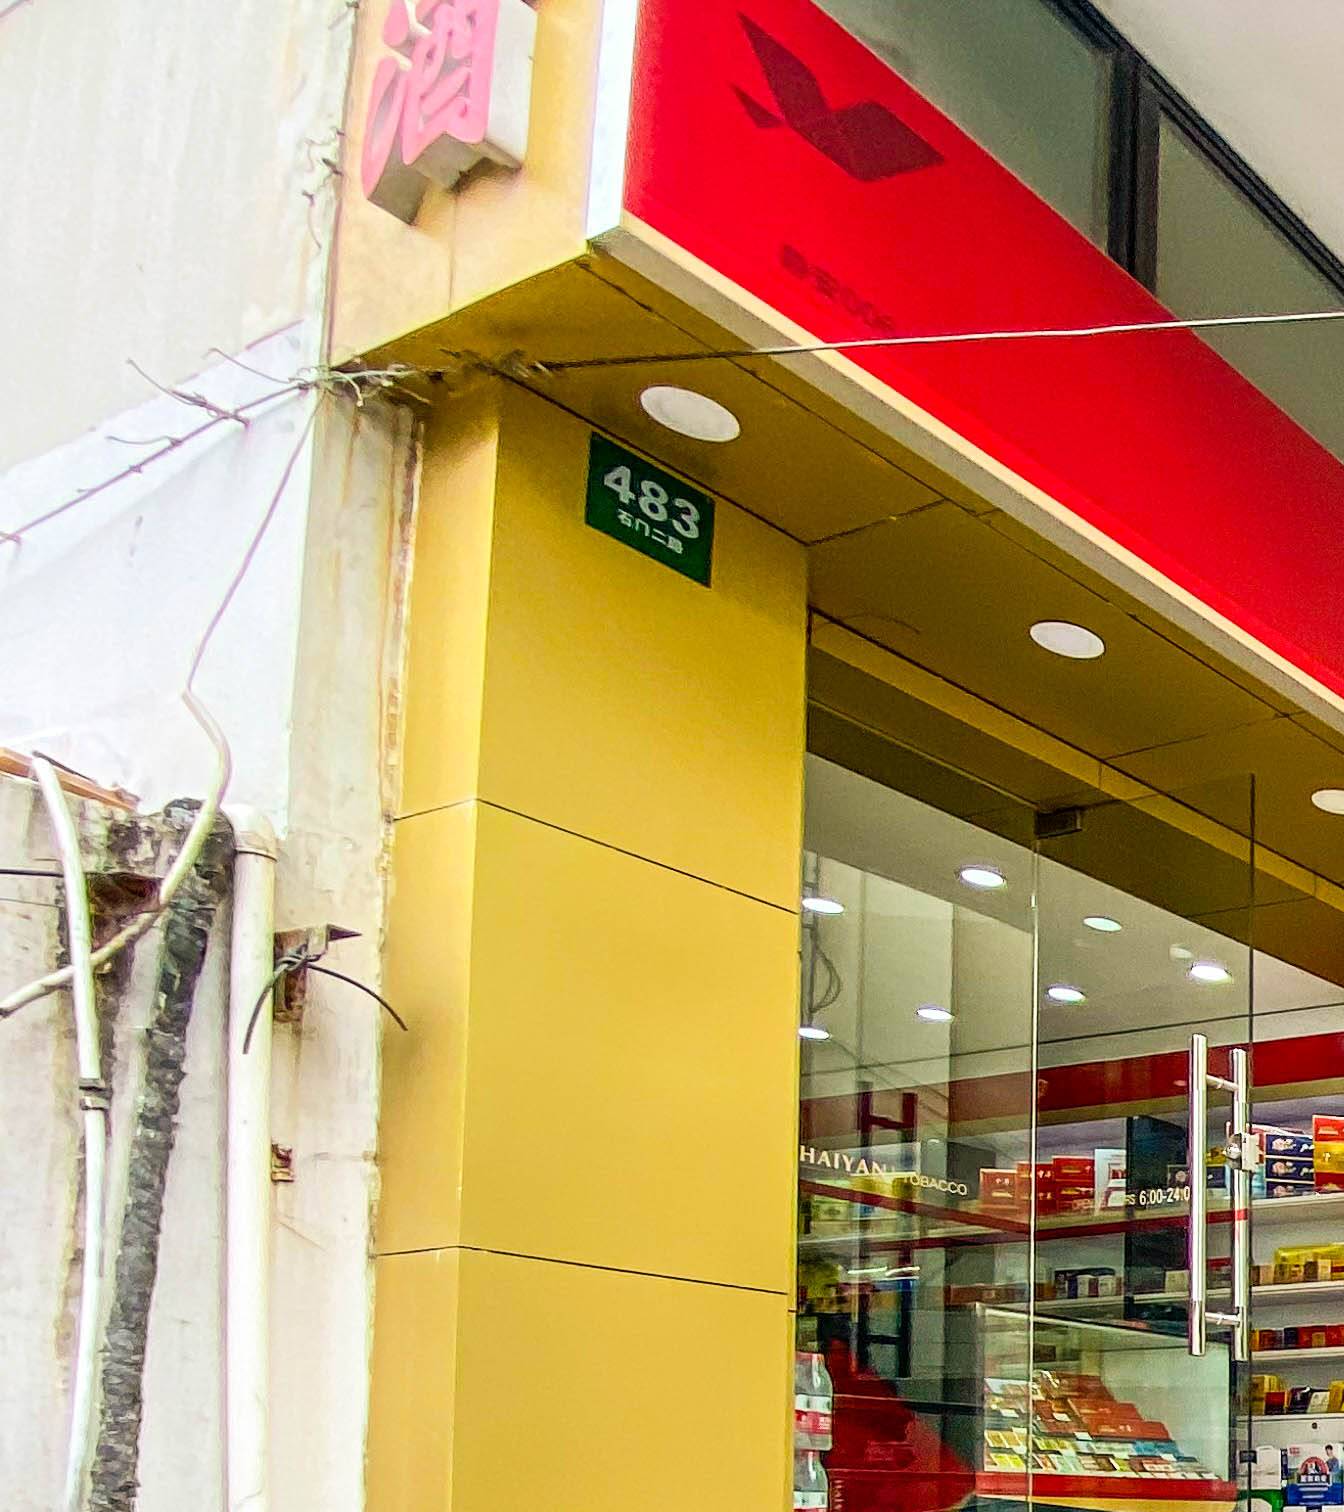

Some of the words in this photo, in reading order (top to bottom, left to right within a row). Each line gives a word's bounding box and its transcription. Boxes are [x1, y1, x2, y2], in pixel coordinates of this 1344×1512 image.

[604, 465, 700, 539] 483
[617, 508, 683, 554] 石门二路
[800, 1145, 888, 1181] HAIYAN
